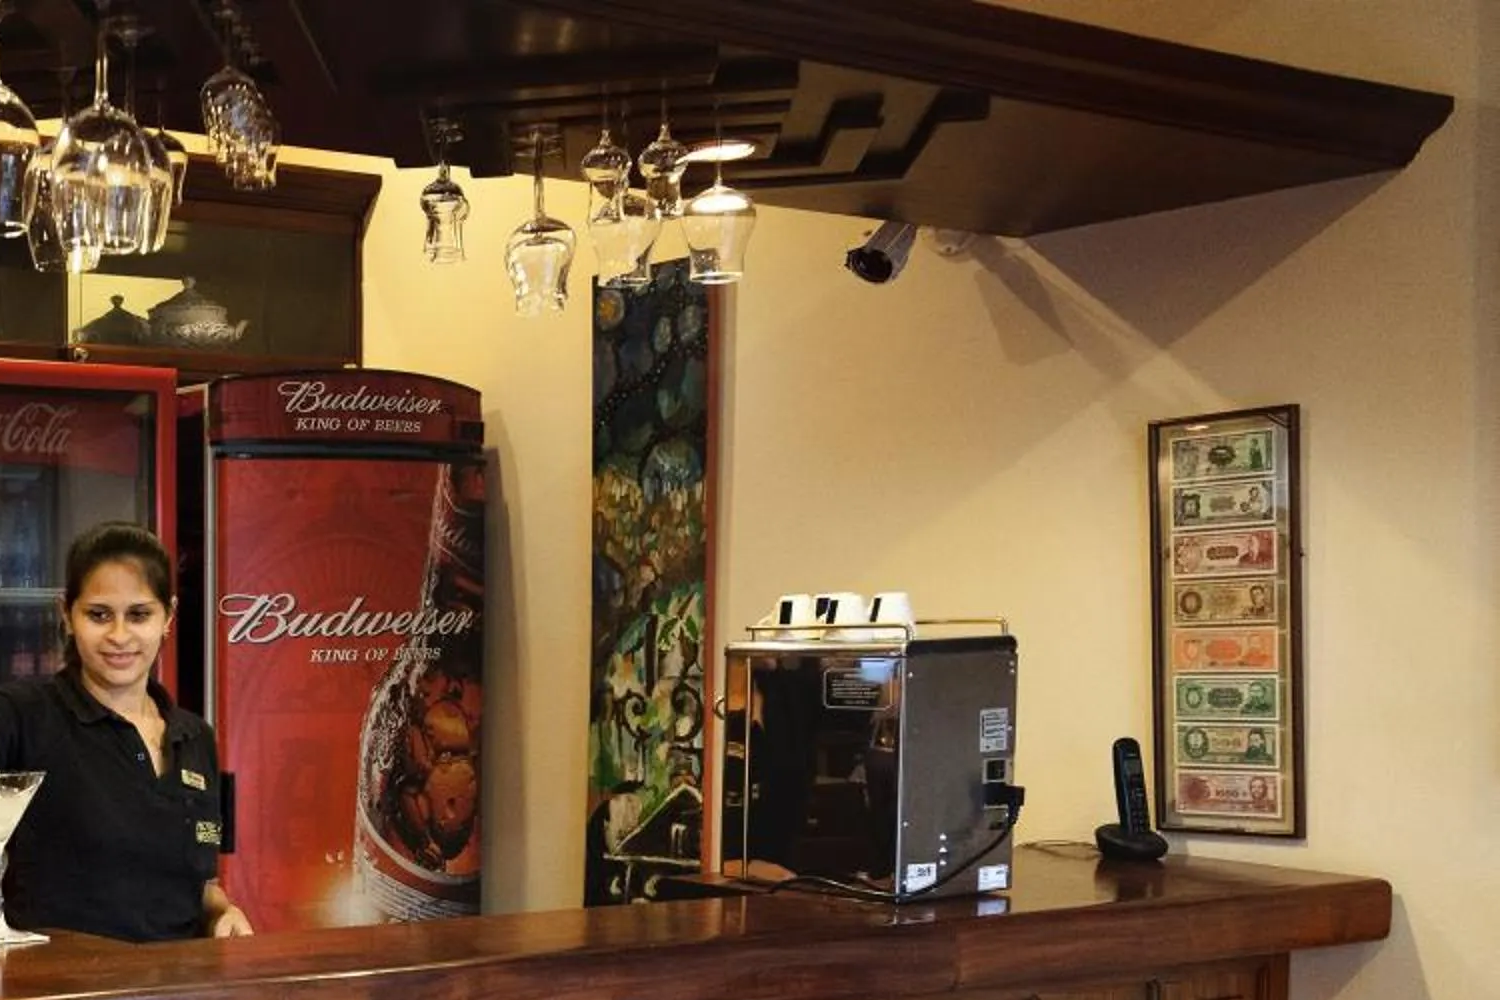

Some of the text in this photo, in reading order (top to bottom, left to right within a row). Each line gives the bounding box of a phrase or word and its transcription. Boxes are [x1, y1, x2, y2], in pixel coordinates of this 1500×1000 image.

[277, 381, 442, 414] Budweiser
[295, 417, 421, 433] KING OF BEERS
[219, 593, 473, 643] Budweiser
[310, 648, 358, 662] KING
[365, 649, 388, 661] OF
